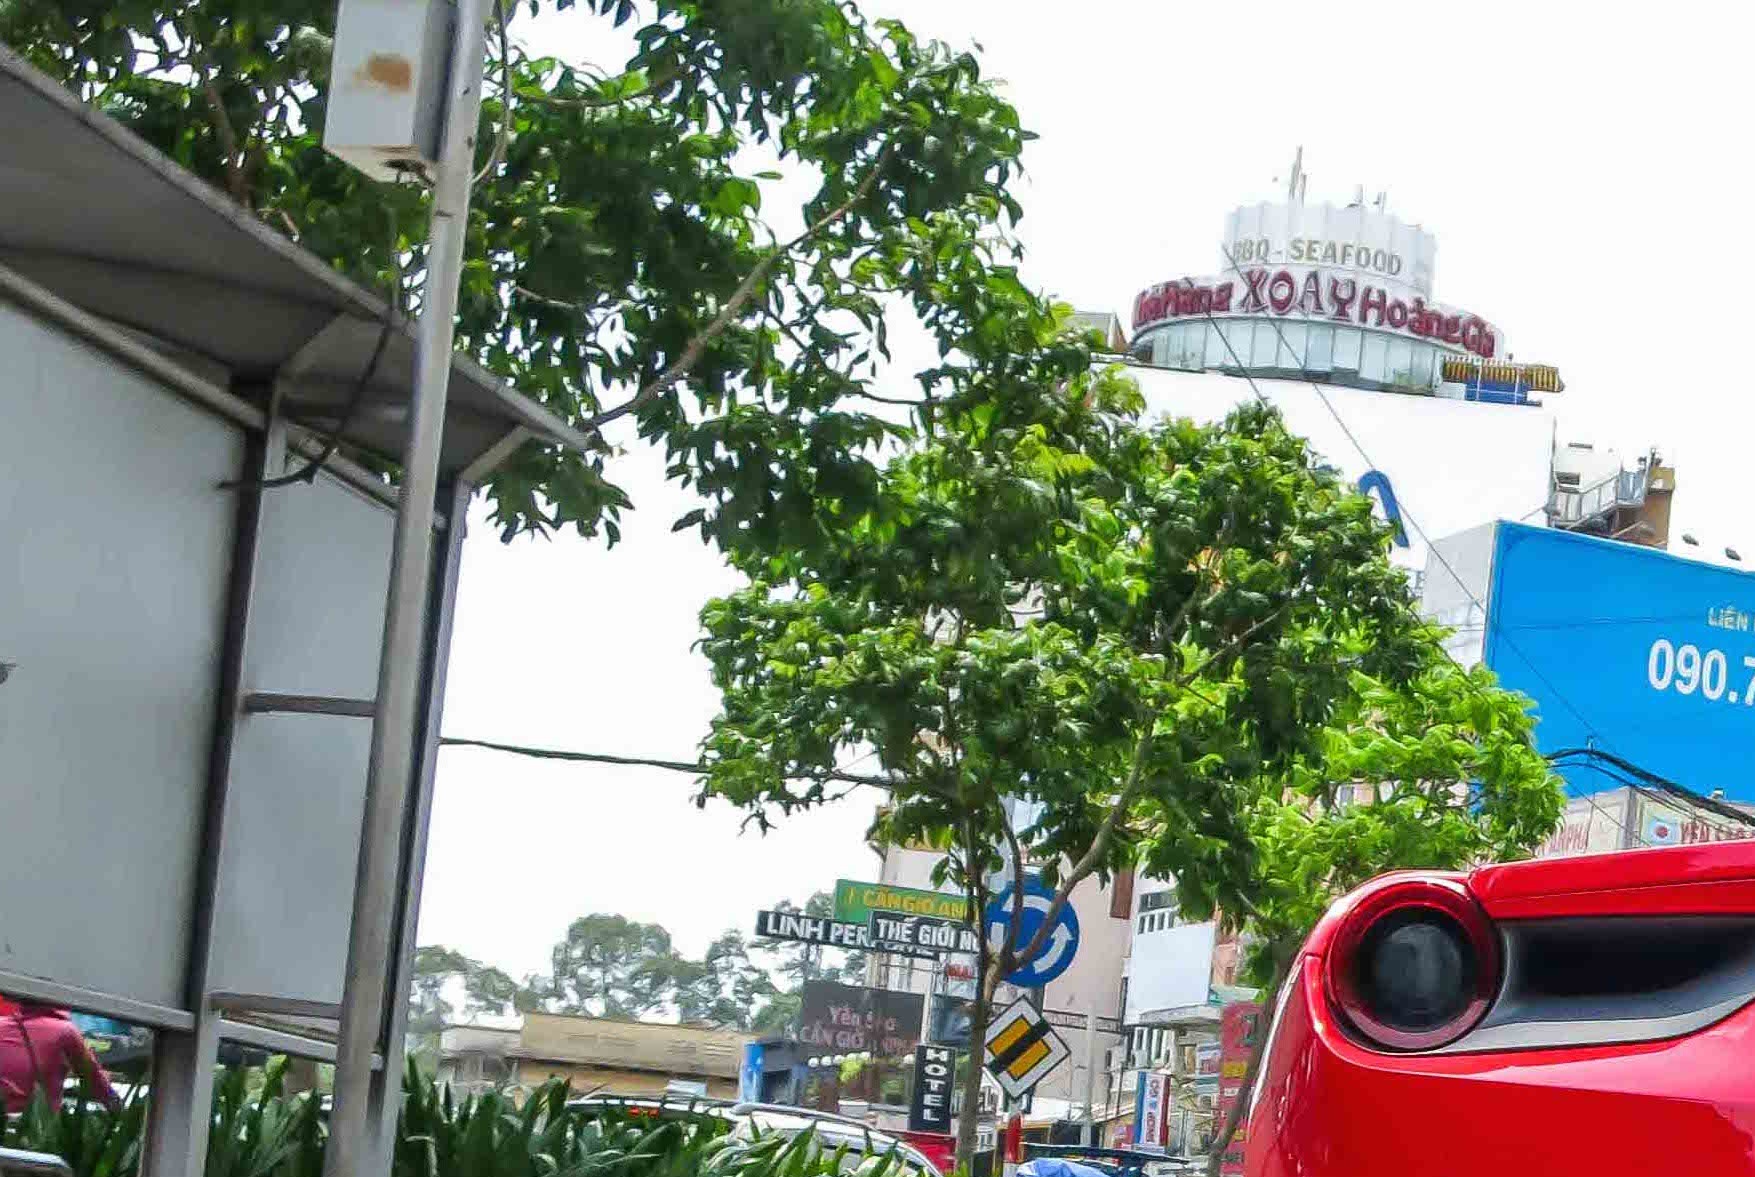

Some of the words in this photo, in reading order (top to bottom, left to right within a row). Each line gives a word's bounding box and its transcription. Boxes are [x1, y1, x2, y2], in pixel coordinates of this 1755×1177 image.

[1290, 239, 1402, 275] SEAFOOD
[1239, 269, 1356, 322] XOAY
[1707, 606, 1748, 632] LIÊN
[766, 913, 824, 941] LINH
[877, 916, 915, 943] THẾ
[919, 921, 955, 948] GIỚI
[923, 1048, 949, 1122] HOTEL
